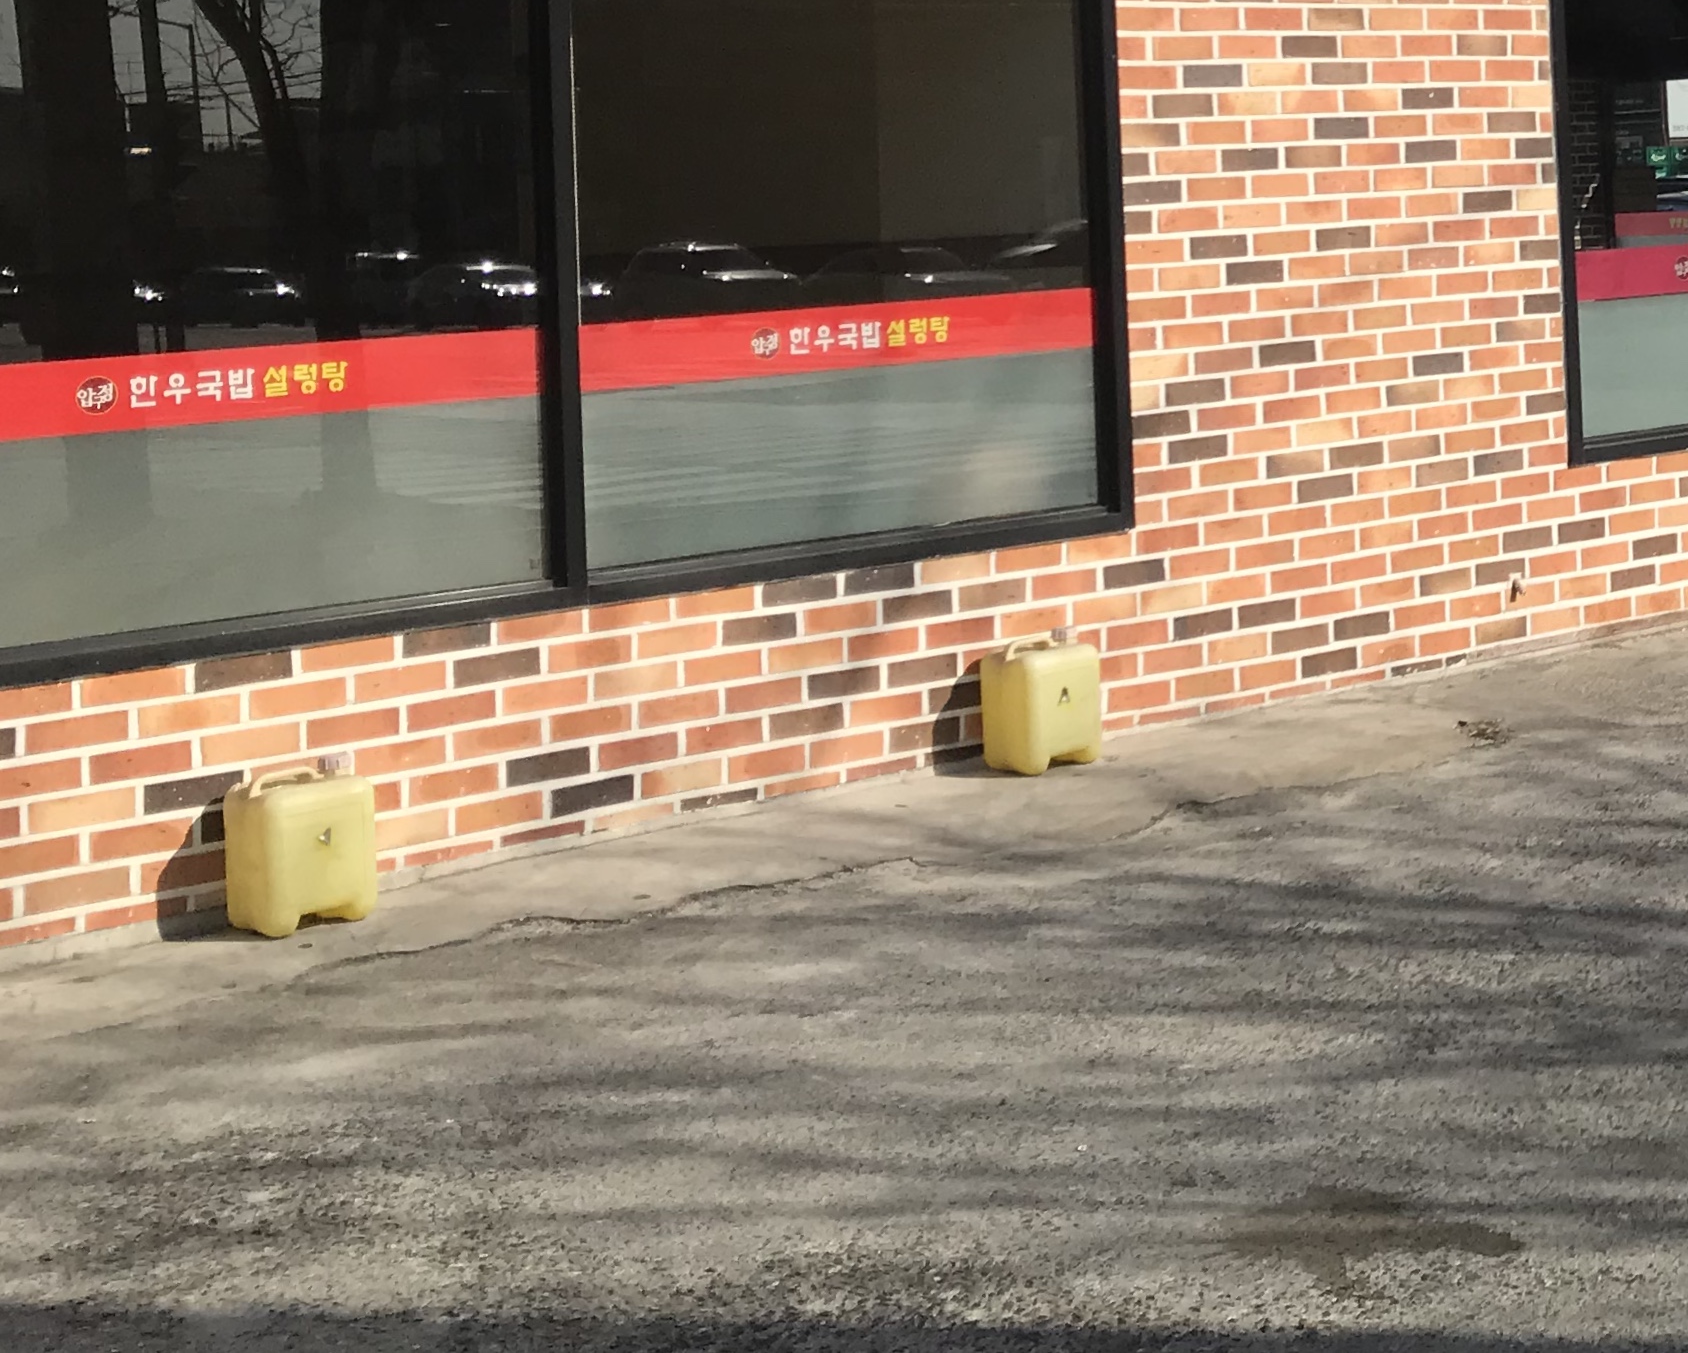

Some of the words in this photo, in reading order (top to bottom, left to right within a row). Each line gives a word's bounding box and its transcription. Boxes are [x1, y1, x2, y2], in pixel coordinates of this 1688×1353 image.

[788, 321, 881, 355] 한우국밥
[886, 316, 950, 348] 설렁탕
[76, 382, 114, 409] 압구정
[129, 367, 255, 409] 한우국밥
[262, 361, 349, 398] 설렁탕
